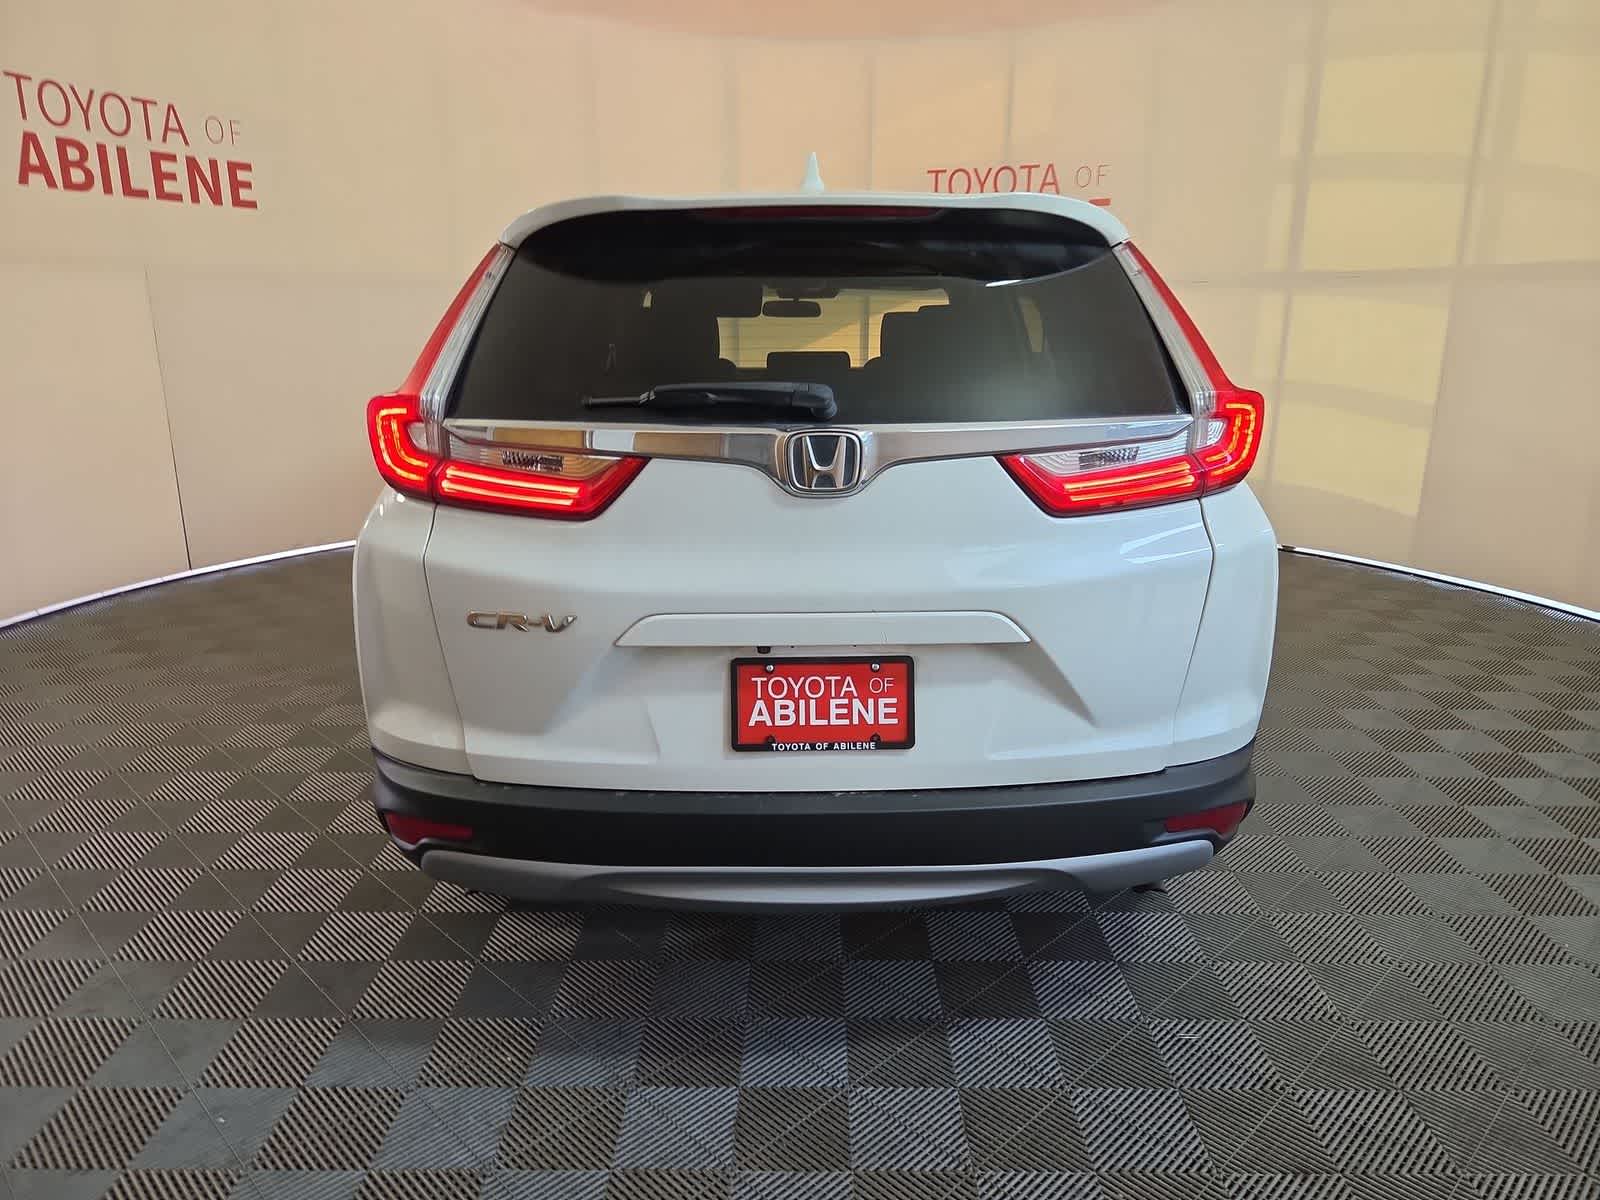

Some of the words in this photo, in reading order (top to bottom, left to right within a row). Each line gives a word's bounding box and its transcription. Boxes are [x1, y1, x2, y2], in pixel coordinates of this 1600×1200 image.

[2, 70, 190, 147] TOYOTA
[204, 115, 241, 146] OF
[17, 130, 258, 209] ABILENE
[927, 163, 1060, 195] TOYOTA
[1074, 164, 1111, 189] OF
[466, 610, 578, 633] CR-V
[751, 676, 858, 699] TOYOTA
[869, 677, 895, 694] OF
[748, 697, 899, 727] ABILENE
[771, 743, 811, 751] TOYOTA
[815, 742, 829, 750] OF
[833, 741, 876, 750] ABILENE
